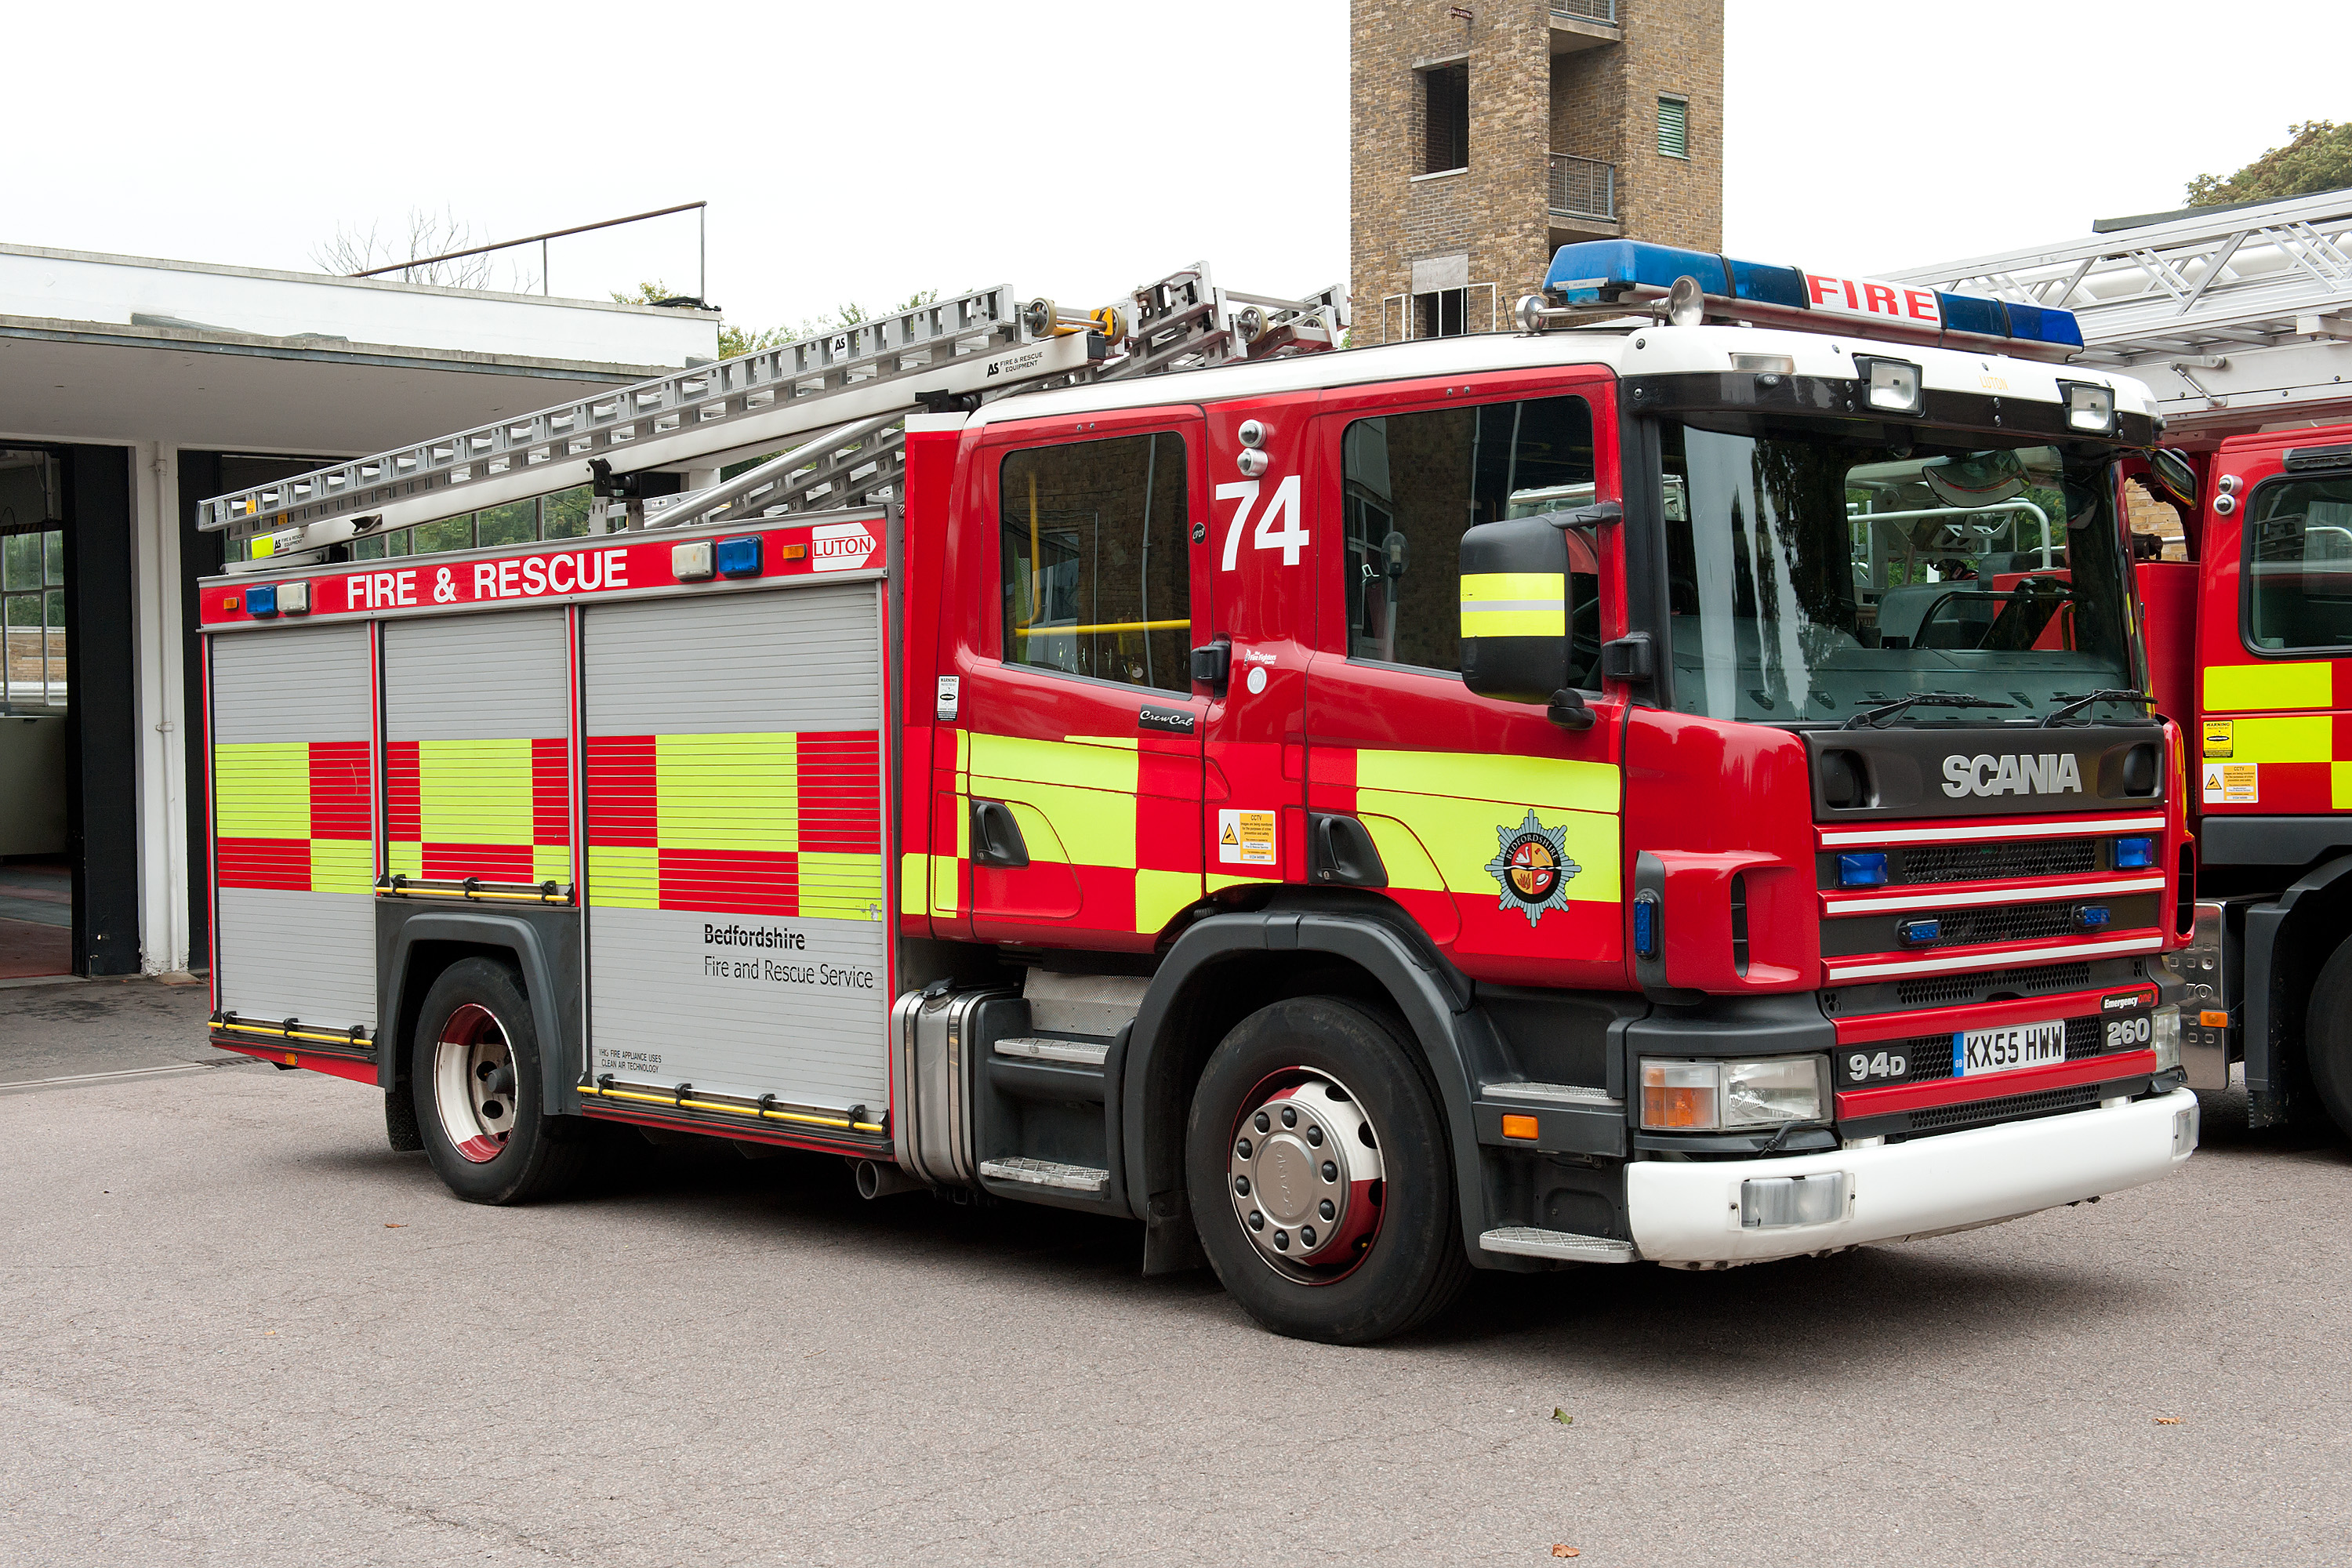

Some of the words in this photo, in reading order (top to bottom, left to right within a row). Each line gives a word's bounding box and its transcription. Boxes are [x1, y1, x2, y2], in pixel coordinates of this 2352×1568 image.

[1806, 274, 1938, 321] FIRE
[834, 337, 845, 352] AS
[1000, 358, 1013, 367] FIRE
[1019, 351, 1043, 362] RESCUE
[1005, 360, 1038, 372] EQUIPMENT
[986, 361, 1000, 378] AS
[1978, 375, 2009, 390] LUTON
[1215, 474, 1310, 572] 74
[274, 539, 281, 550] AS
[284, 539, 303, 547] EQUIPMENT
[814, 537, 871, 557] LUTON
[347, 570, 417, 610] FIRE
[433, 567, 457, 604] &
[474, 549, 629, 600] RESCUE
[1139, 710, 1194, 727] CrewCab
[1941, 753, 2082, 798] SCANIA
[1506, 833, 1559, 859] BEDFORDSHIRE
[704, 924, 805, 950] Bedfordshire
[705, 955, 729, 978] Fire
[734, 958, 759, 980] and
[764, 960, 815, 984] Rescue
[820, 964, 873, 989] Service
[2107, 1018, 2151, 1047] 260
[610, 1049, 621, 1058] FIRE
[622, 1051, 647, 1062] APPLIANCE
[648, 1054, 662, 1063] USES
[1967, 1032, 2019, 1069] KX55
[2026, 1025, 2063, 1062] HWW
[601, 1058, 617, 1068] CLEAN
[627, 1062, 659, 1073] TECHNOLOGY
[1849, 1051, 1906, 1081] 94D
[1955, 1058, 1963, 1068] GB
